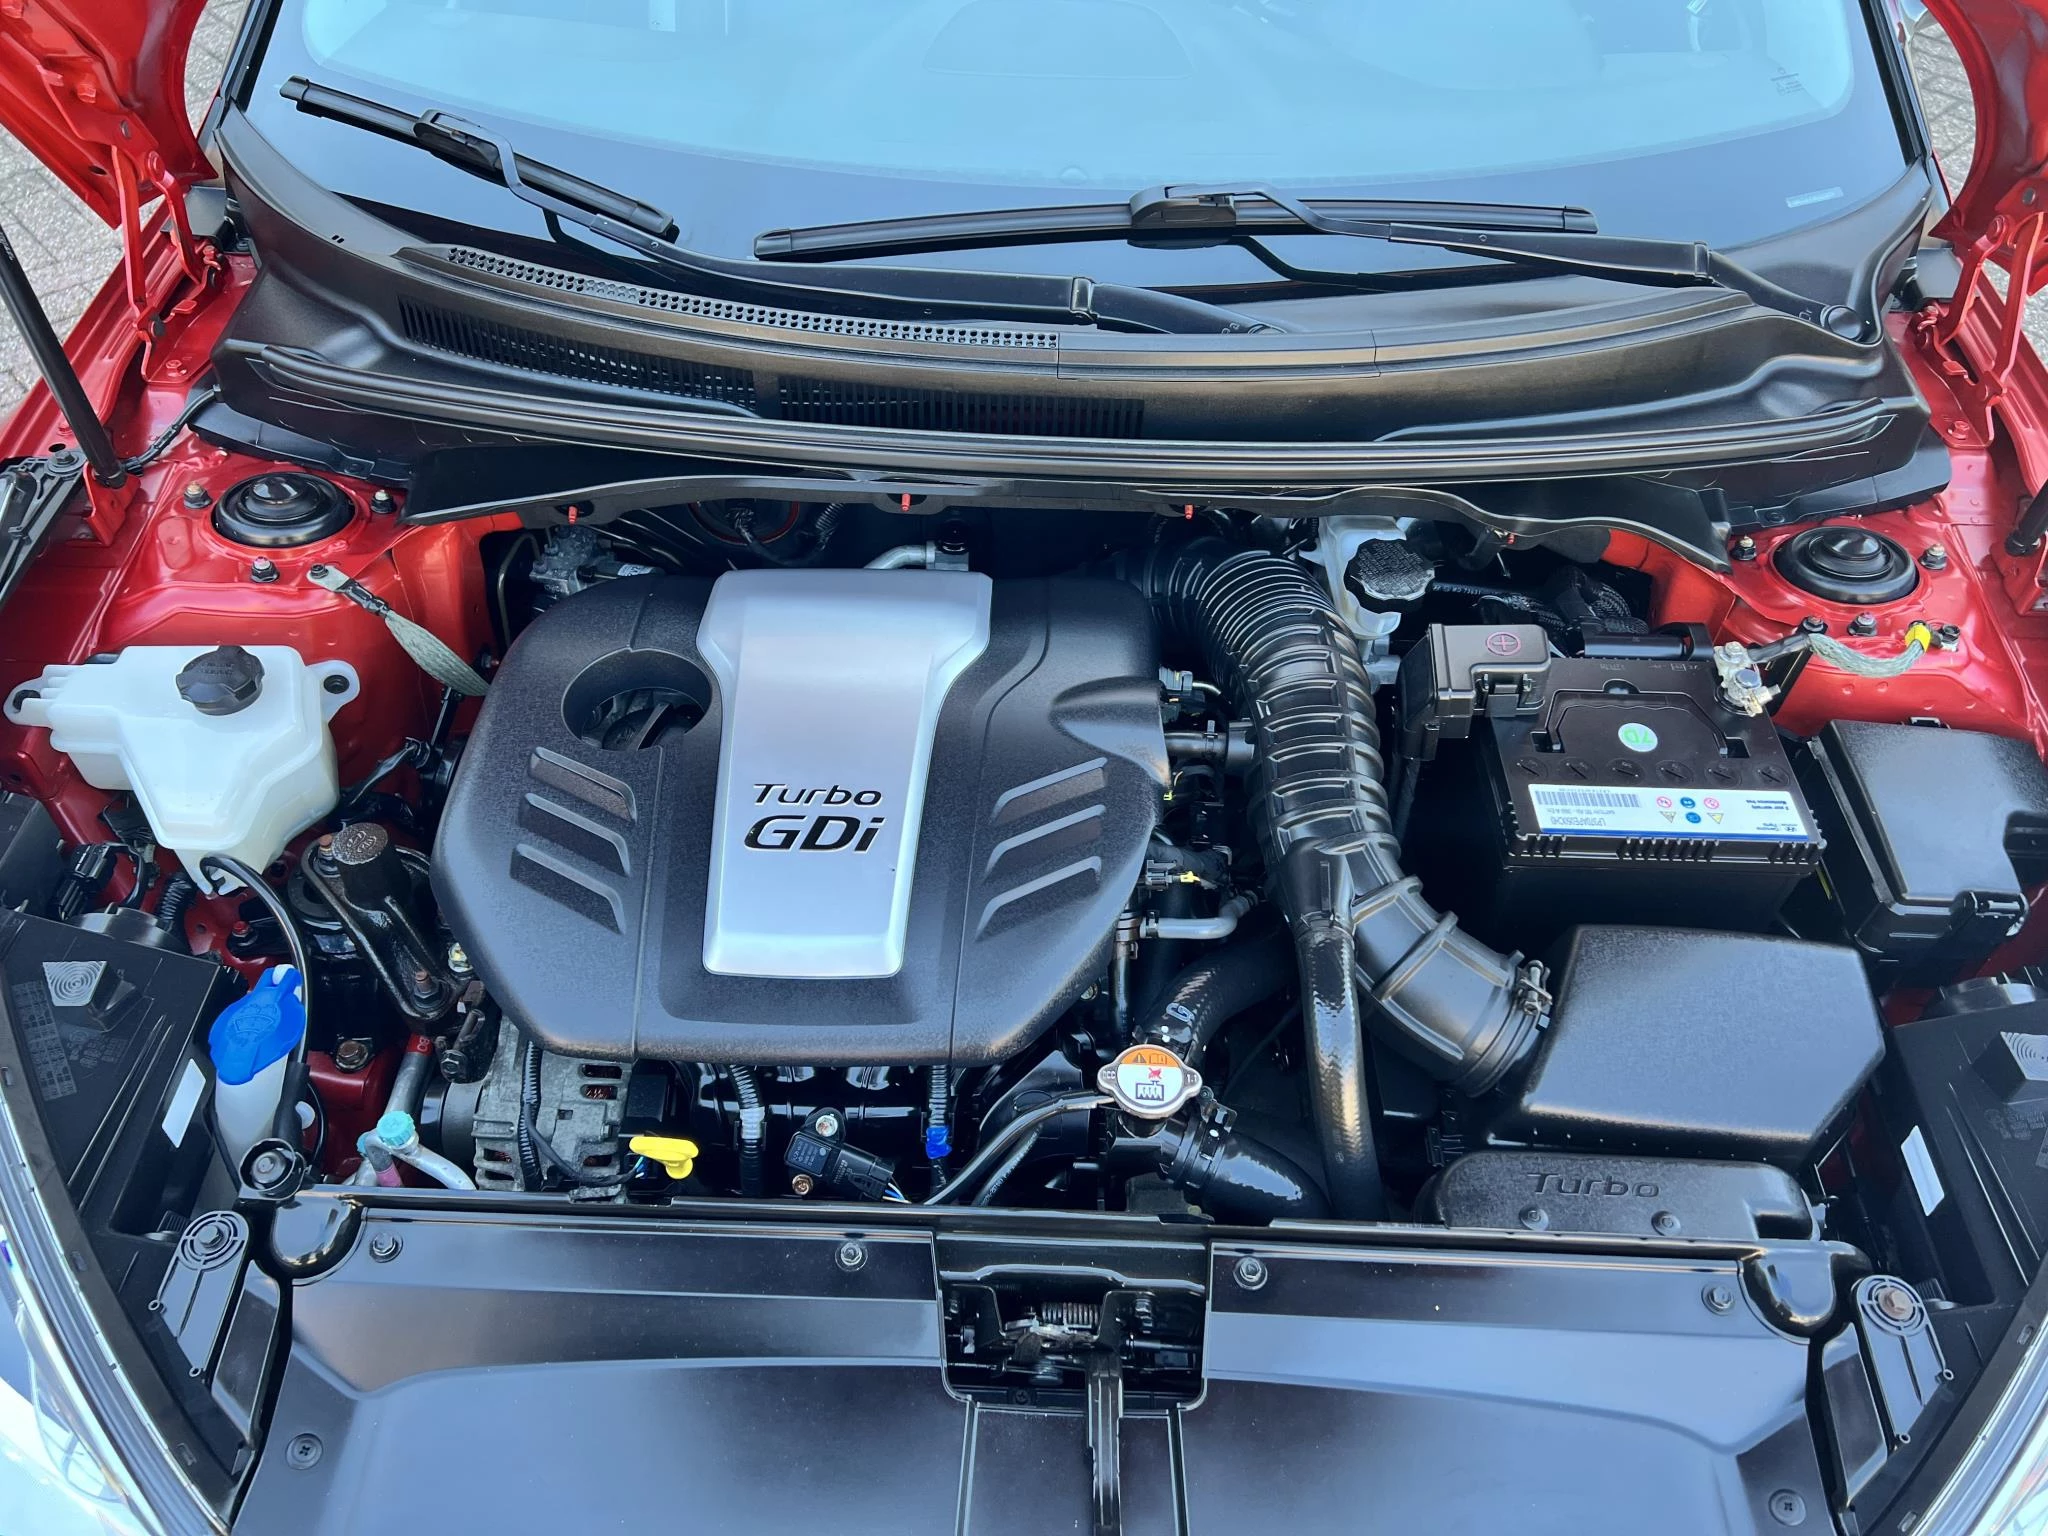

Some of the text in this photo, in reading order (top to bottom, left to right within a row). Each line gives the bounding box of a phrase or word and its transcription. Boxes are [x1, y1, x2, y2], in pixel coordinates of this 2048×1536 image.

[753, 784, 882, 806] Turbo
[744, 814, 886, 853] GDi
[1527, 1172, 1661, 1199] Turbo
